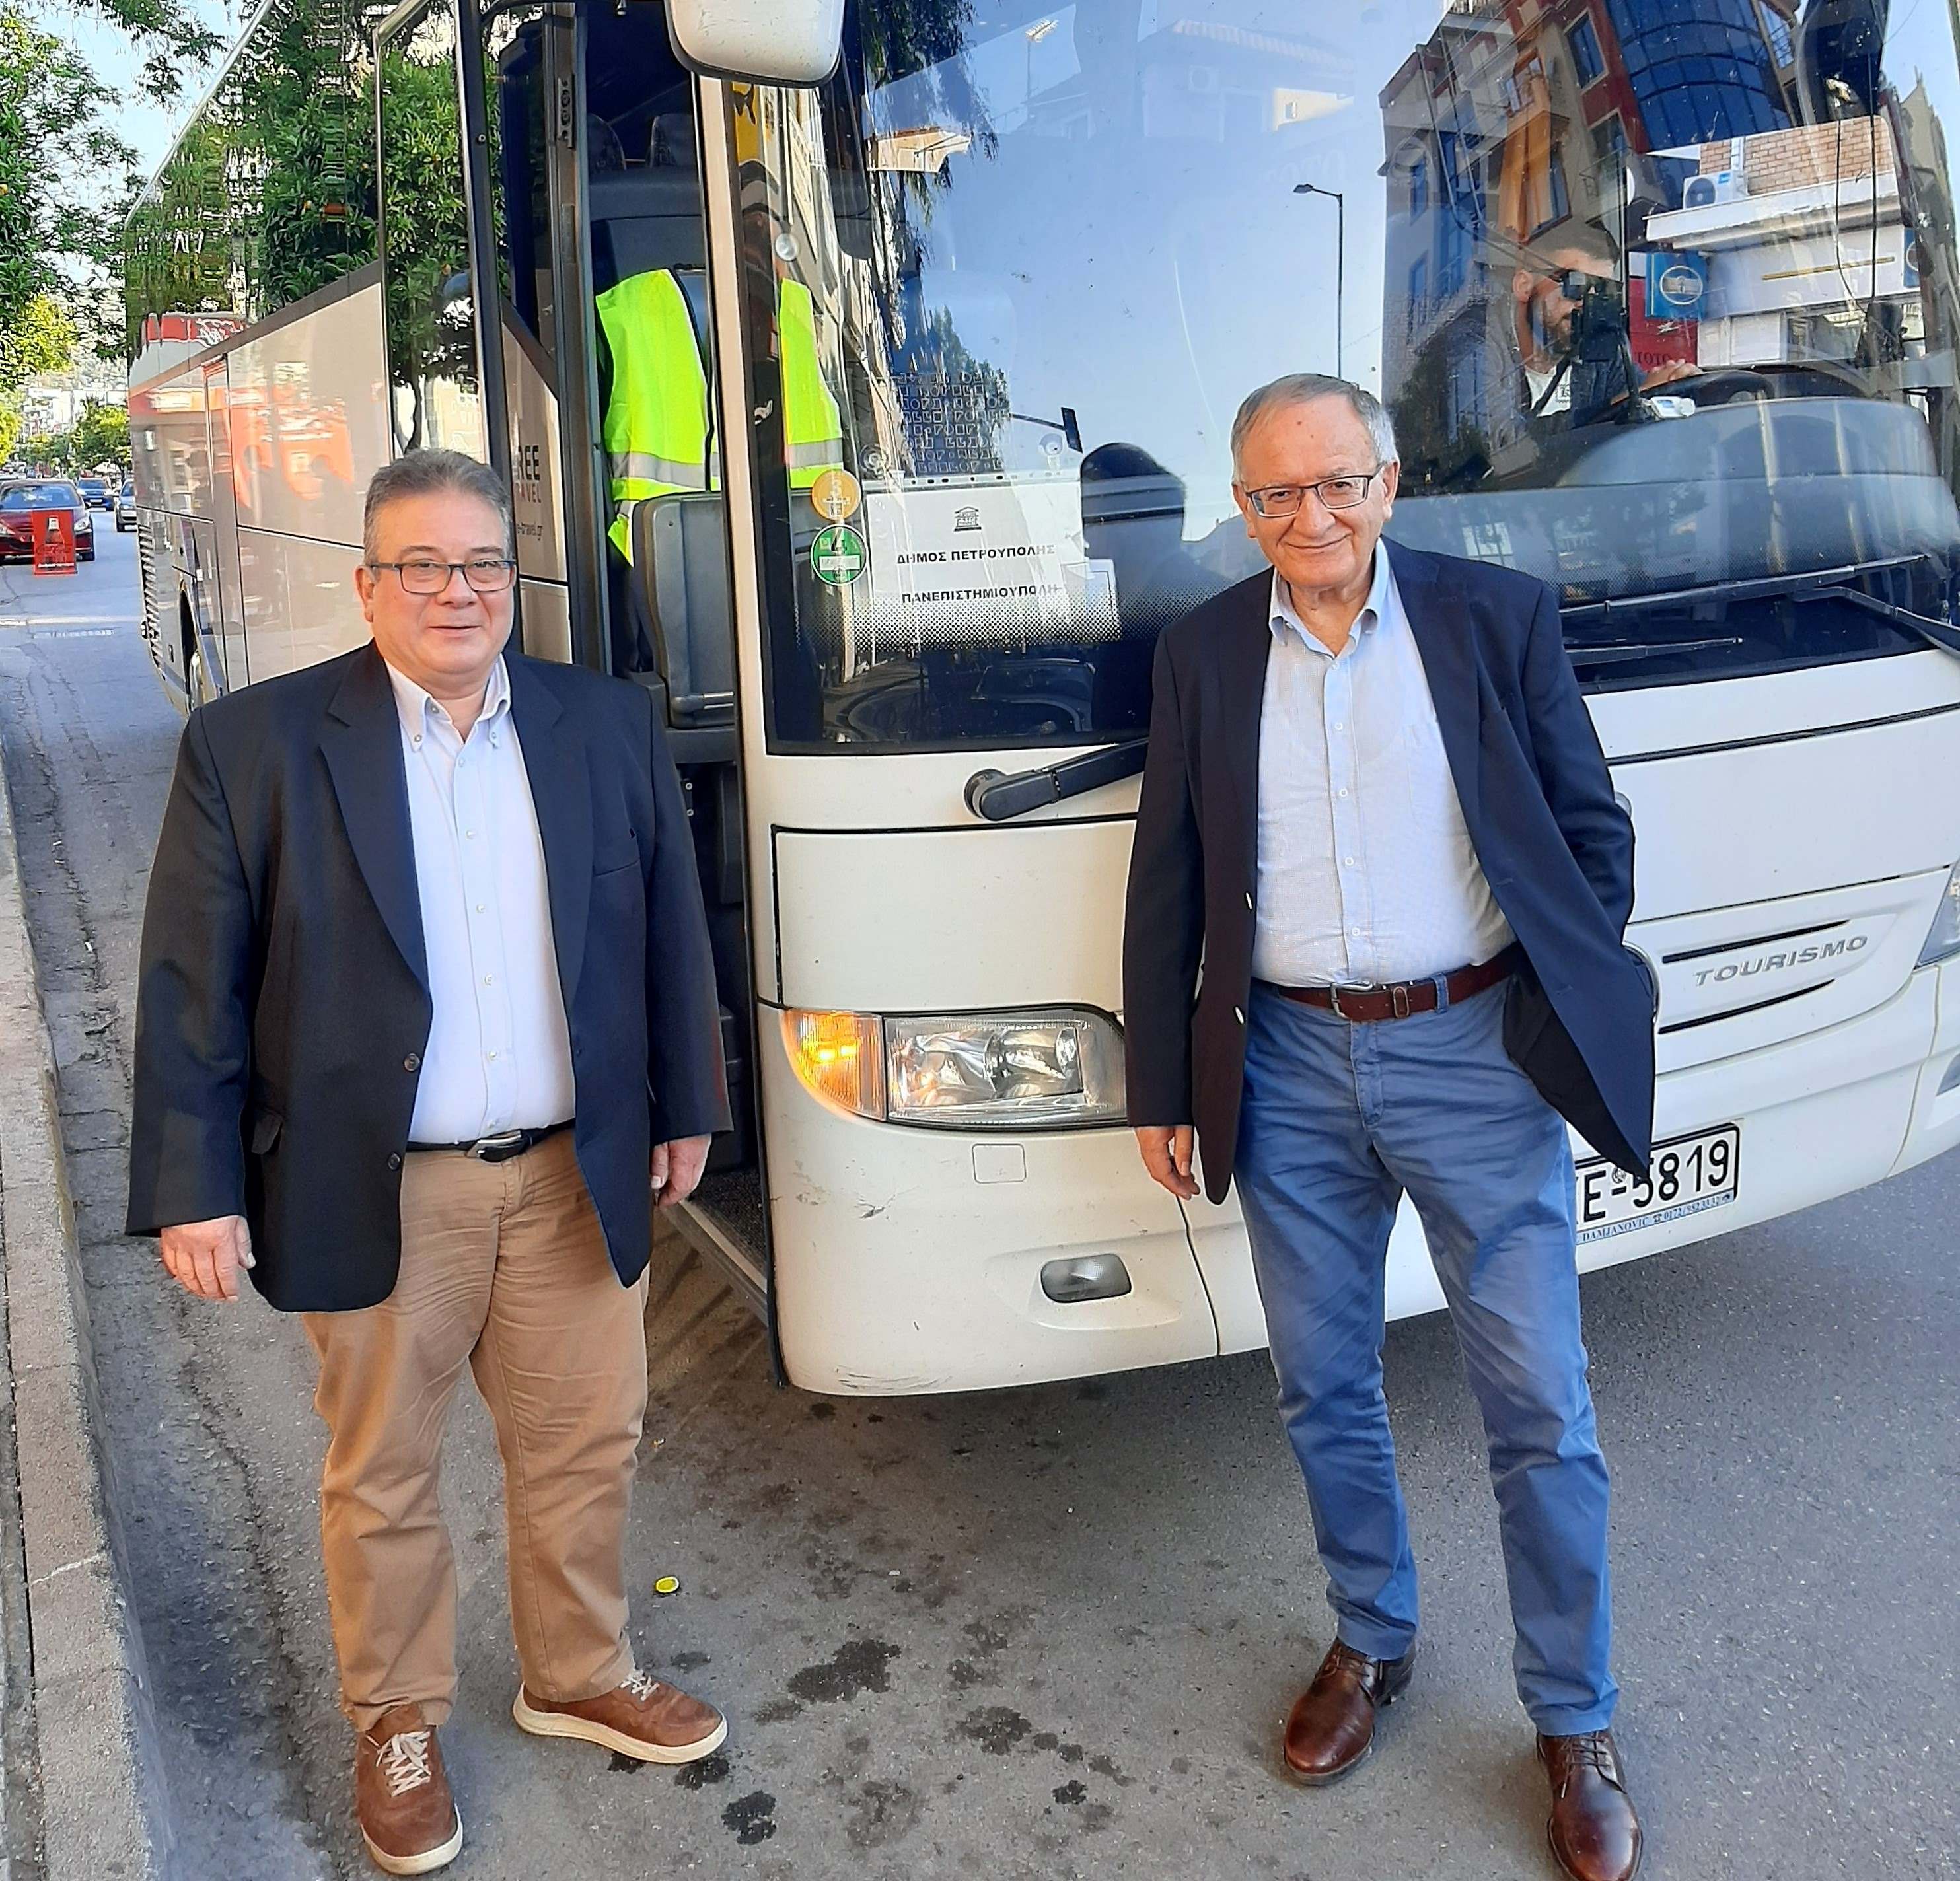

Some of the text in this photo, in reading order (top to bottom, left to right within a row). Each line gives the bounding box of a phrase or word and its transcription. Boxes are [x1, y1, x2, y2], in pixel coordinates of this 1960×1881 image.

[897, 544, 1055, 564] ΔΗΜΟΣ ΠΕΤΡΟΥΠΟΛΗΣ
[1693, 935, 1868, 987] TOURISMO
[1575, 1139, 1729, 1224] E-5819
